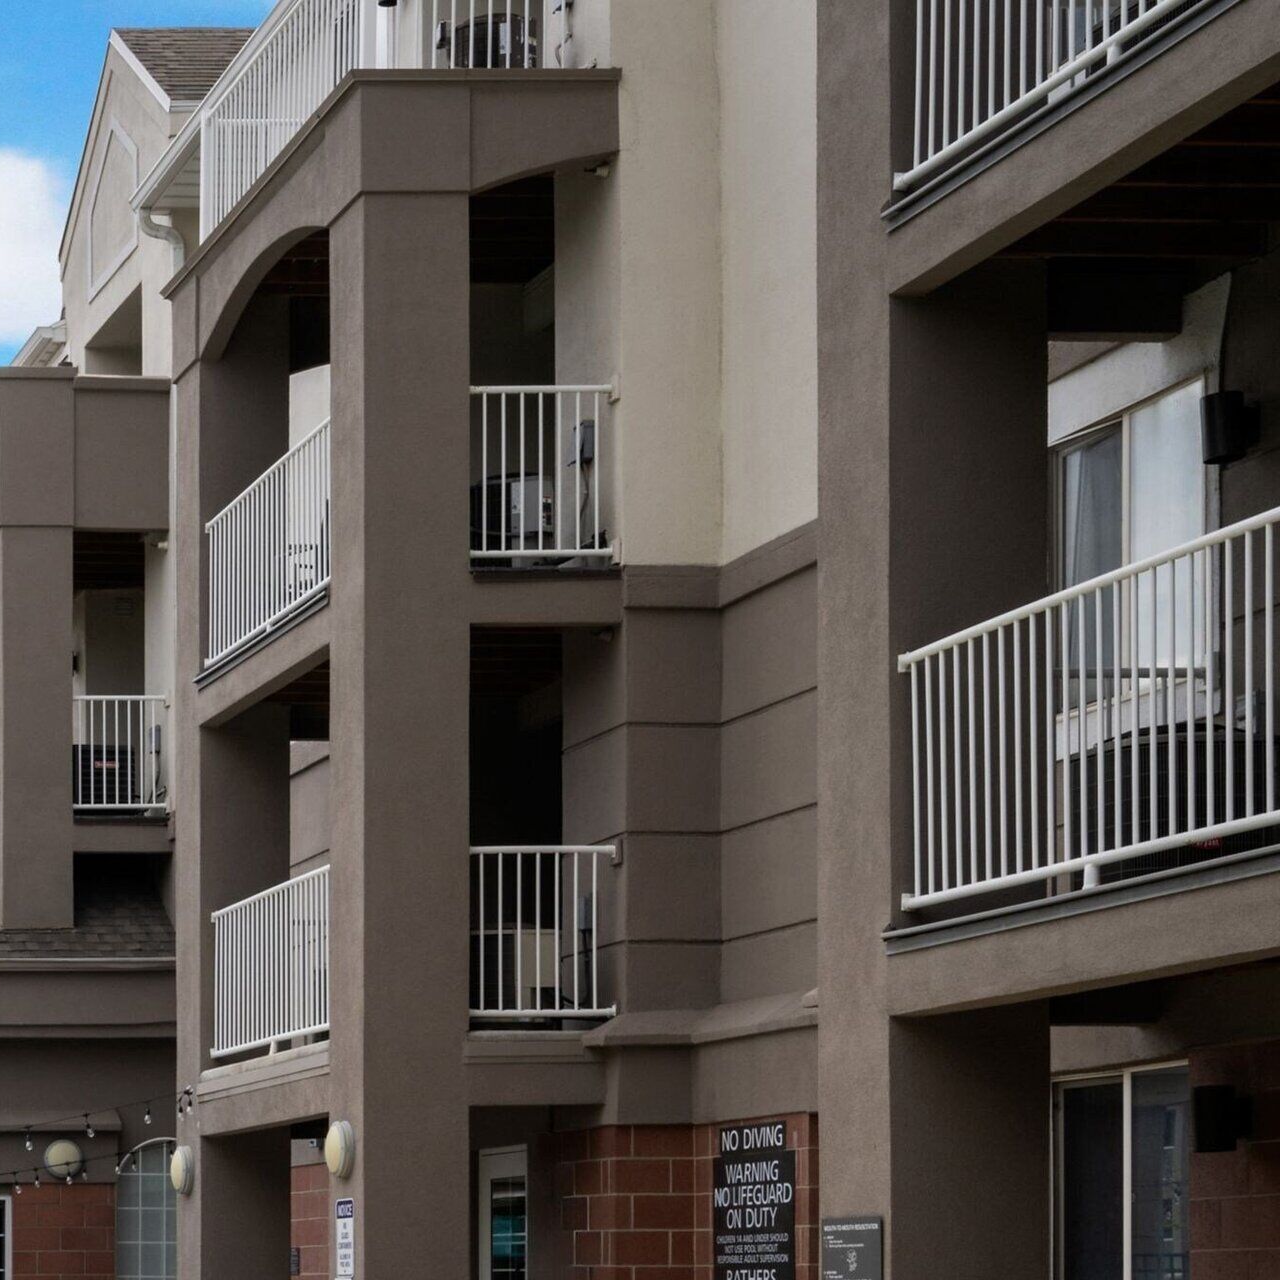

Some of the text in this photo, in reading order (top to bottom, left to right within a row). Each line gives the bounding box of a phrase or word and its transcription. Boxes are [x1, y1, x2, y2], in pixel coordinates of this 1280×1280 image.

[722, 1124, 783, 1152] NO DIVING
[725, 1160, 779, 1184] WARNING
[714, 1182, 793, 1208] NO LIFEGUARD
[726, 1207, 777, 1229] ON DUTY
